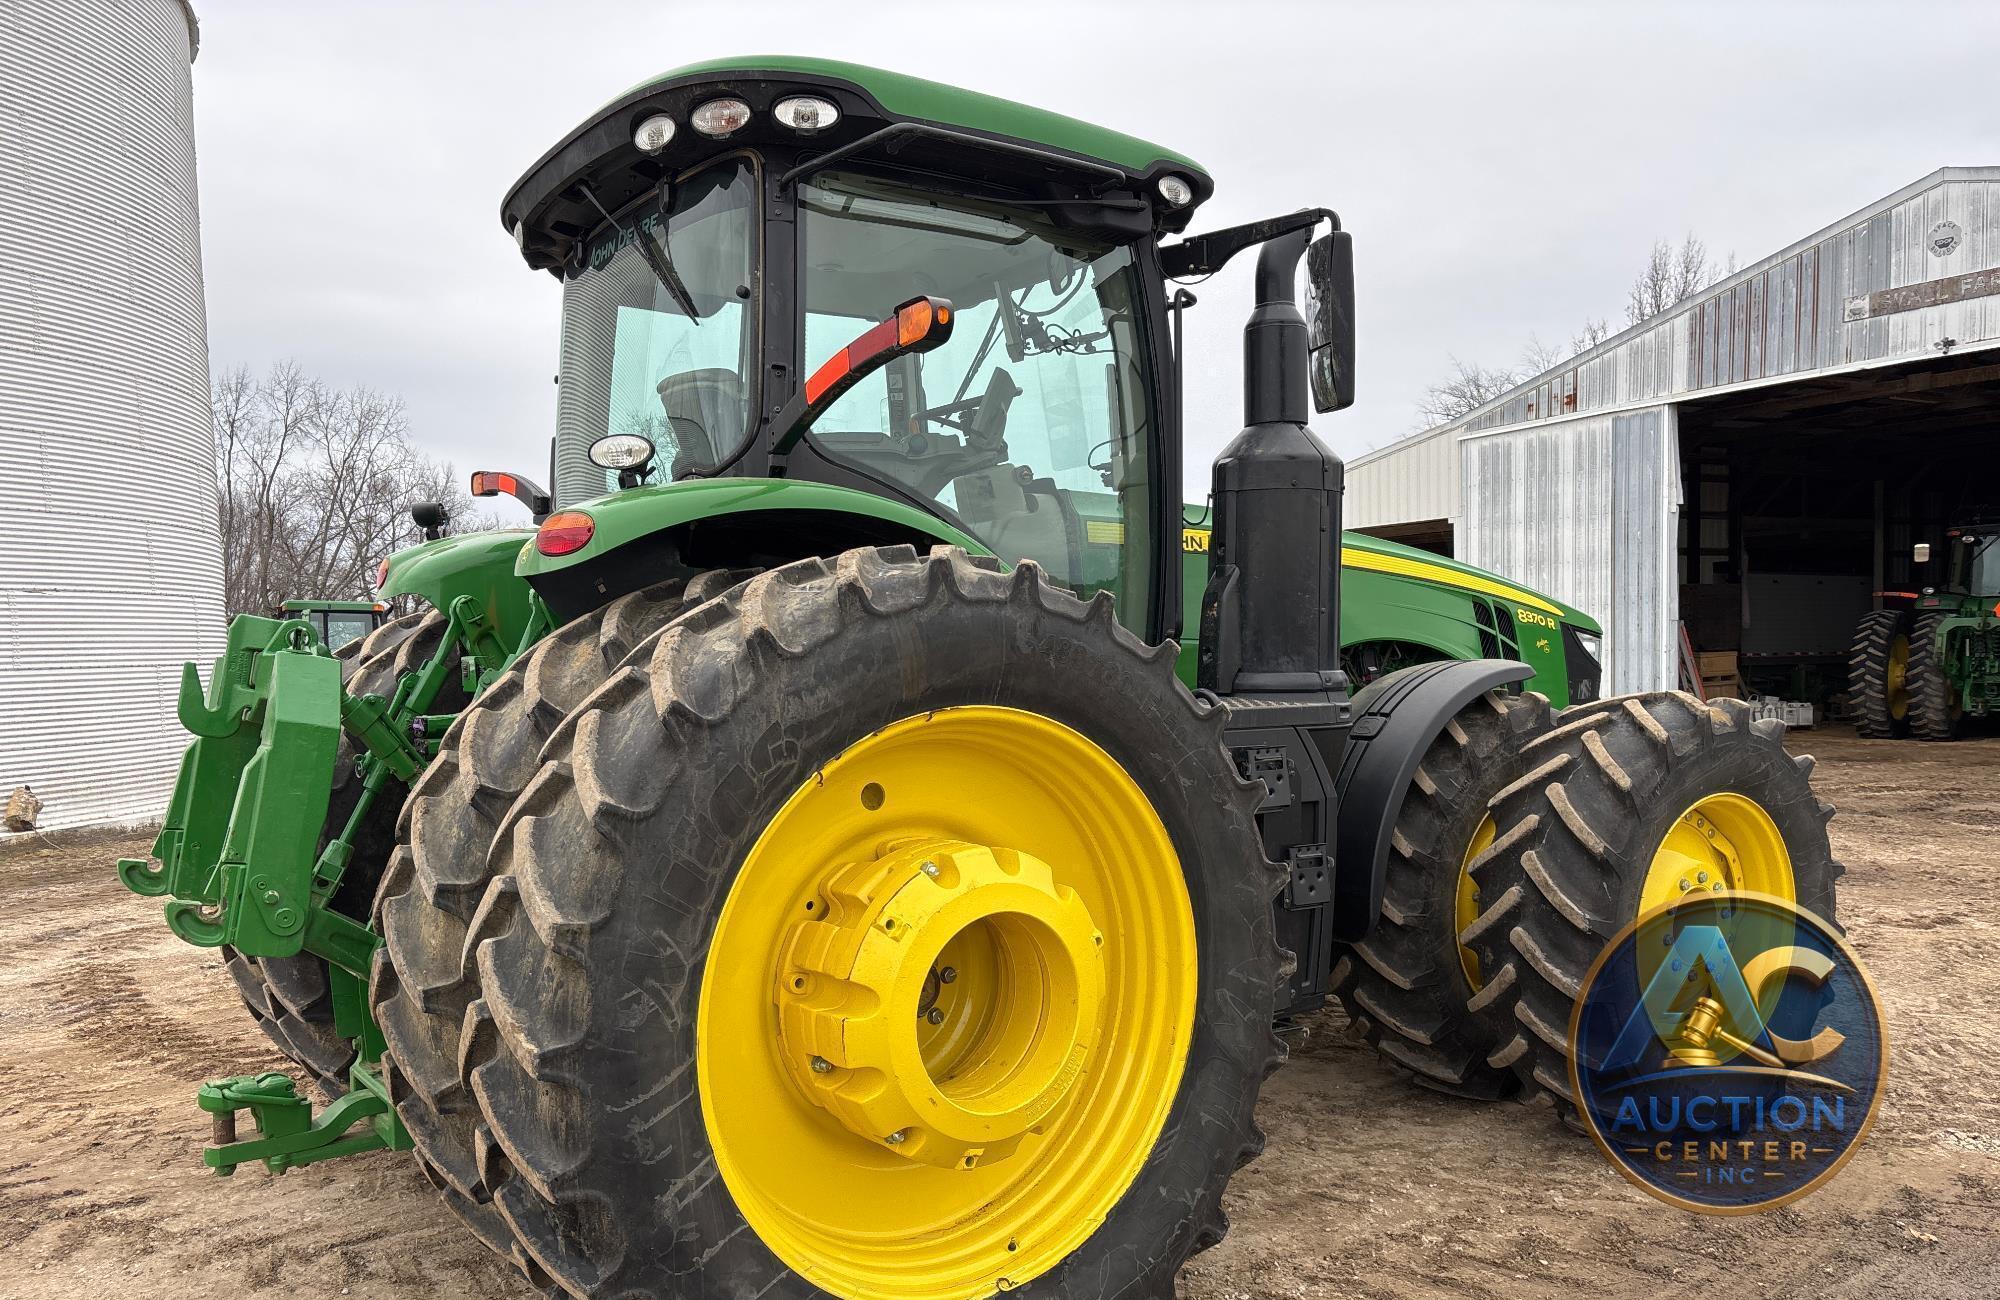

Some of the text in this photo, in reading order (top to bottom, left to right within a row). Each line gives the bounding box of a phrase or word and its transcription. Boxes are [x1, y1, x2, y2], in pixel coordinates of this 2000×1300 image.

[590, 213, 659, 267] JOHN DERE
[1182, 535, 1203, 549] HN
[1517, 608, 1556, 630] 8370 R
